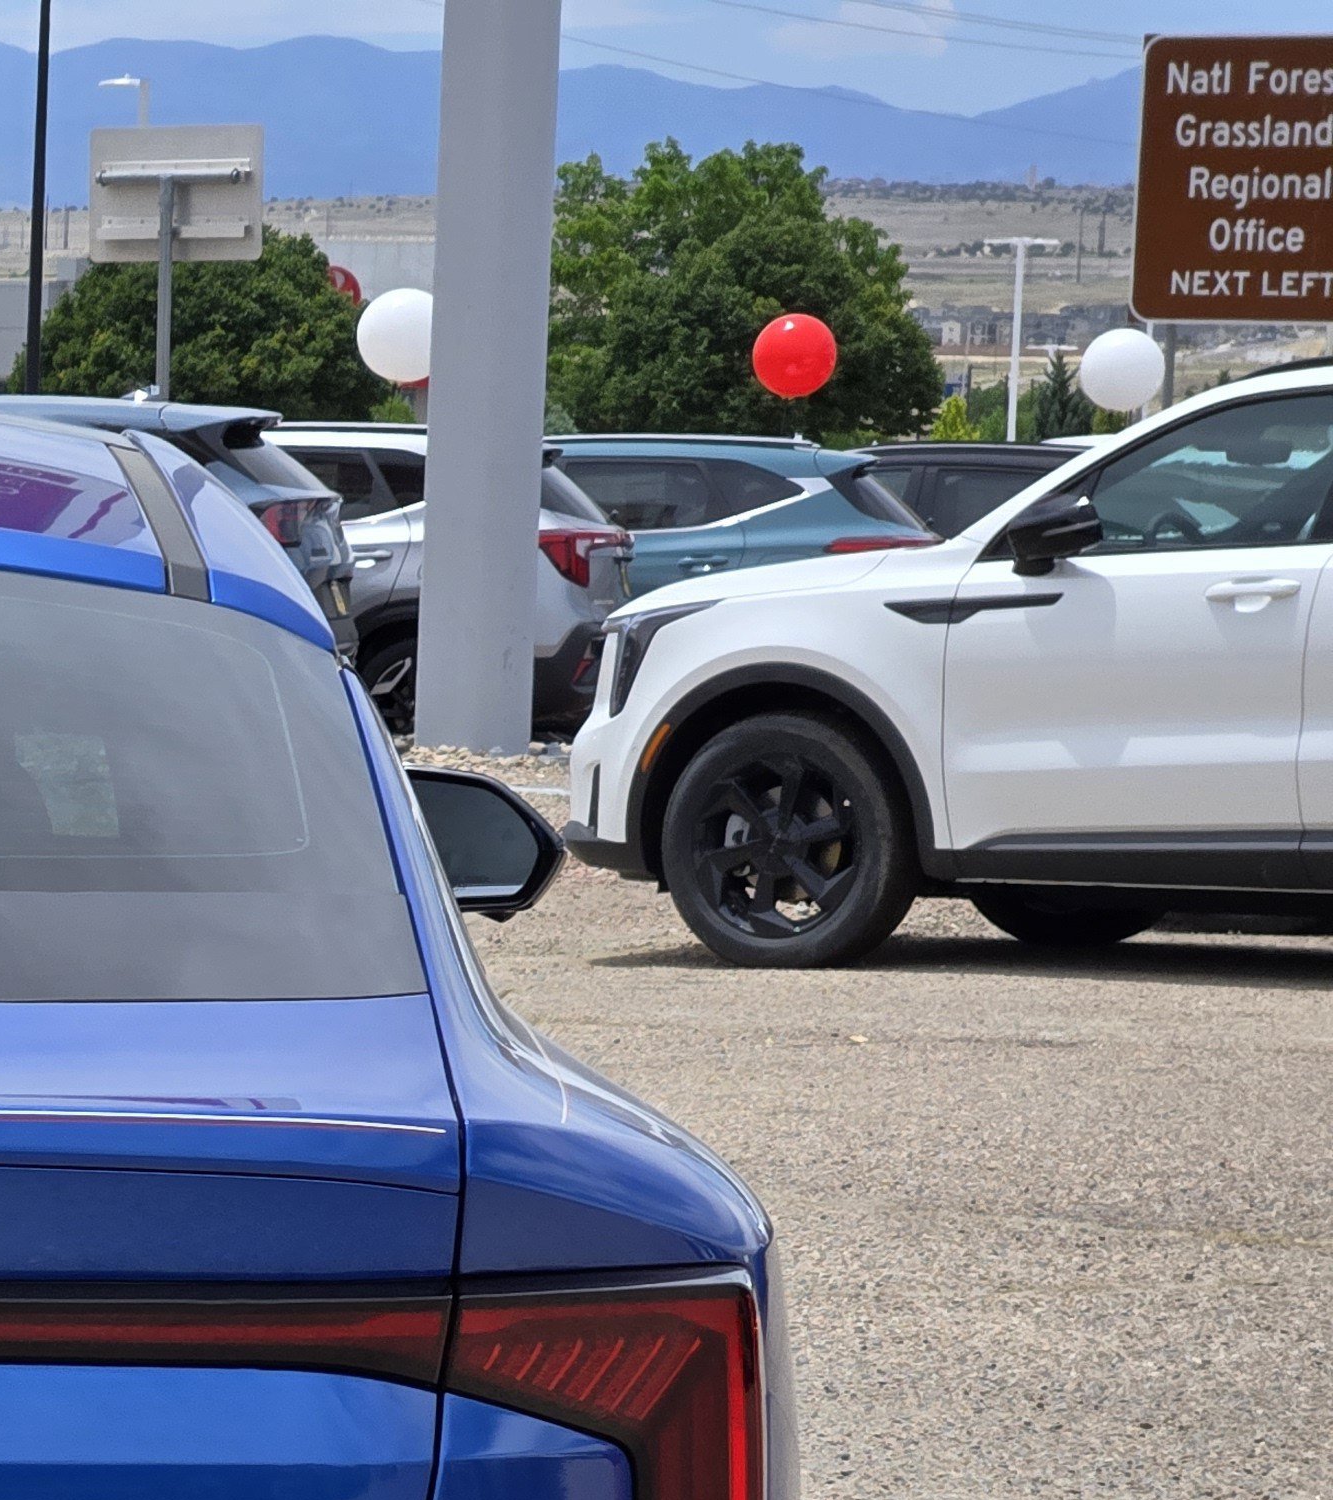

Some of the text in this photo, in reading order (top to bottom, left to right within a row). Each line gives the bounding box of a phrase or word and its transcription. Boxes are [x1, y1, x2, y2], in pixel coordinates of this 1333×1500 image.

[1166, 61, 1231, 94] Natl
[1175, 113, 1333, 148] Grassland
[1188, 166, 1333, 209] Regional
[1209, 218, 1305, 251] Office
[1170, 270, 1333, 297] NEXT LEFT
